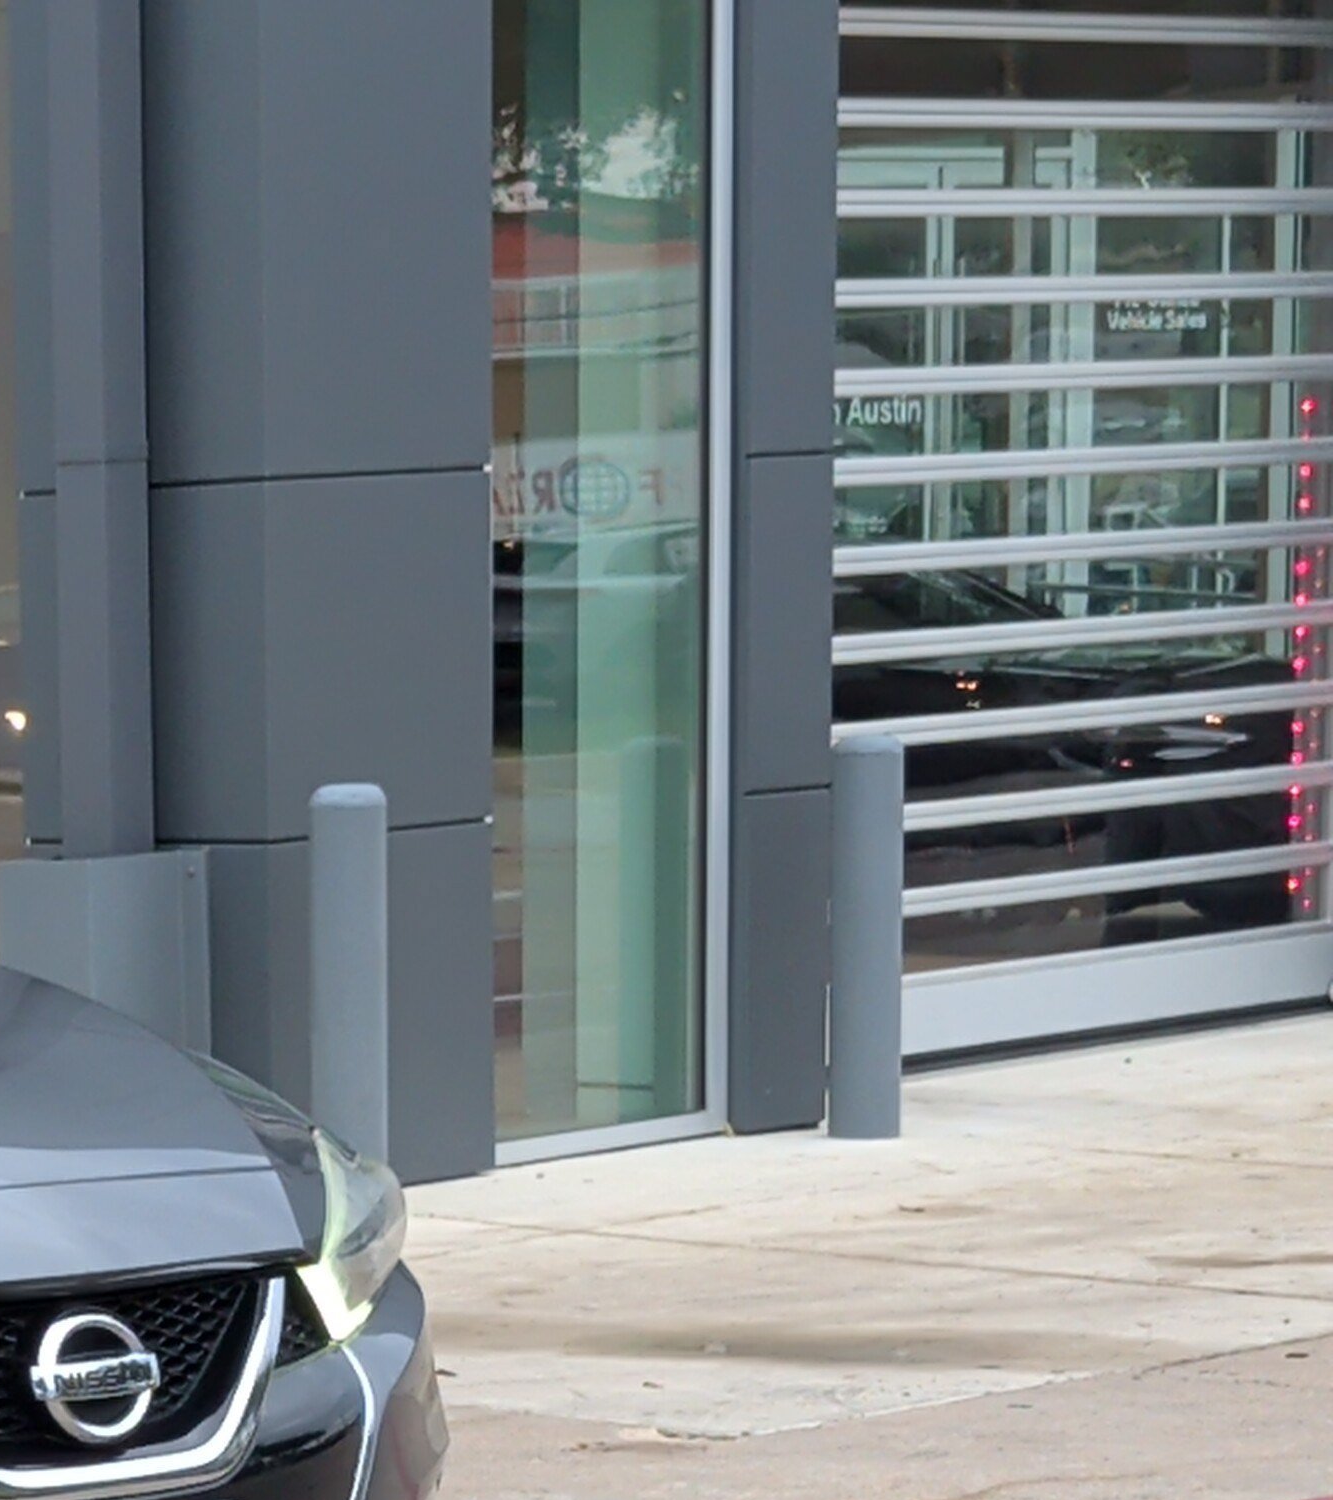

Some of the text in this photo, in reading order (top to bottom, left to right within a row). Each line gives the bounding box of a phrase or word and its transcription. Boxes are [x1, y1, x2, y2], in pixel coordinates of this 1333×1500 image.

[1106, 308, 1207, 330] Vehicle Sales
[846, 392, 922, 425] Austin
